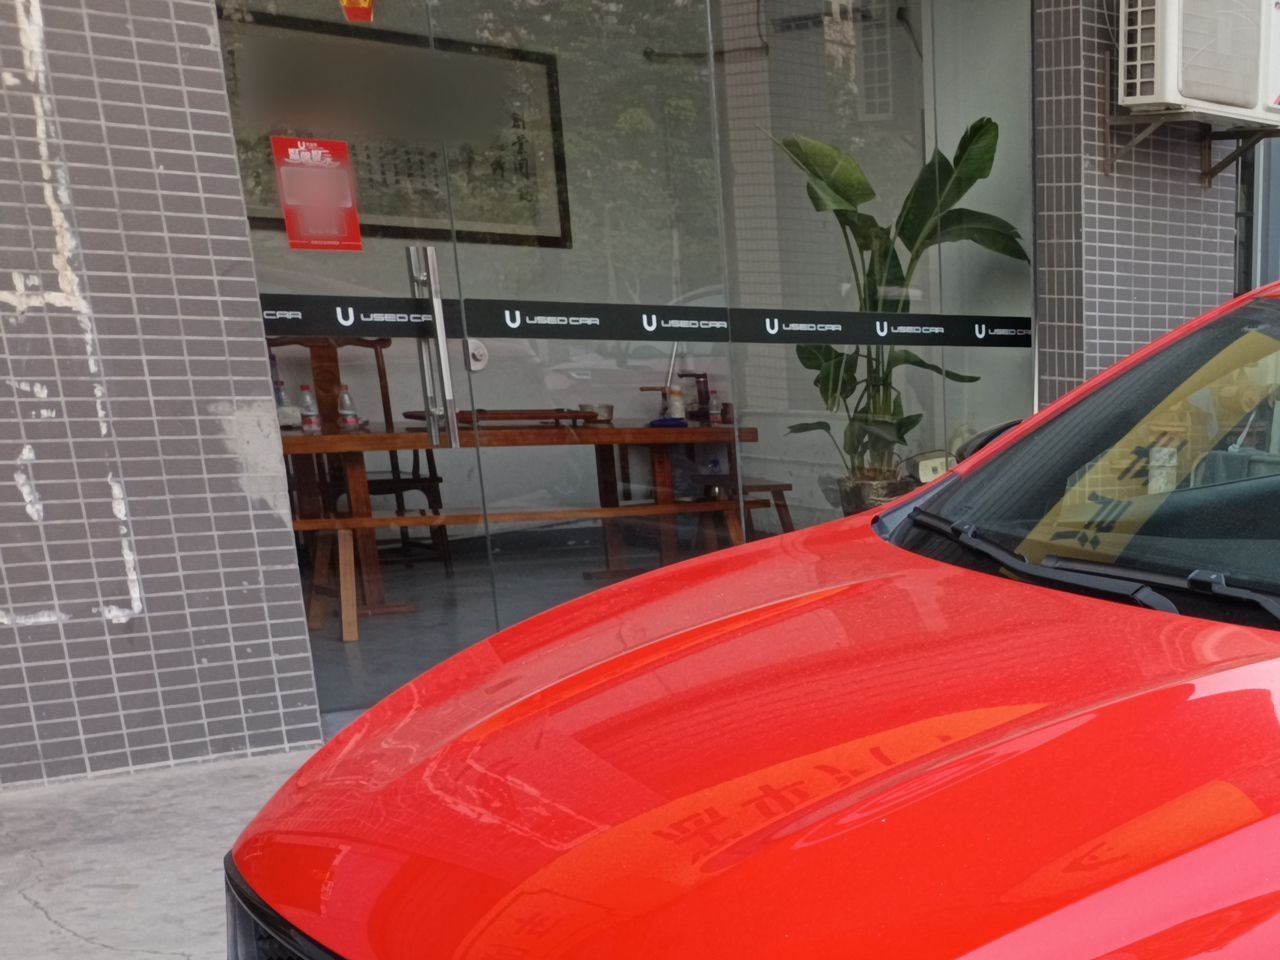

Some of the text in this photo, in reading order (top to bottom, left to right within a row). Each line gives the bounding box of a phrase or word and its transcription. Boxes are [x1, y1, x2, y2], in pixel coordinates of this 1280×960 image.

[360, 313, 408, 322] USED
[526, 316, 568, 325] USED
[568, 316, 600, 325] CAR
[661, 319, 699, 328] USED
[699, 320, 728, 328] CAR
[782, 323, 816, 331] USED
[816, 323, 842, 331] CAR
[890, 325, 922, 333] USED
[922, 326, 945, 334] CAR
